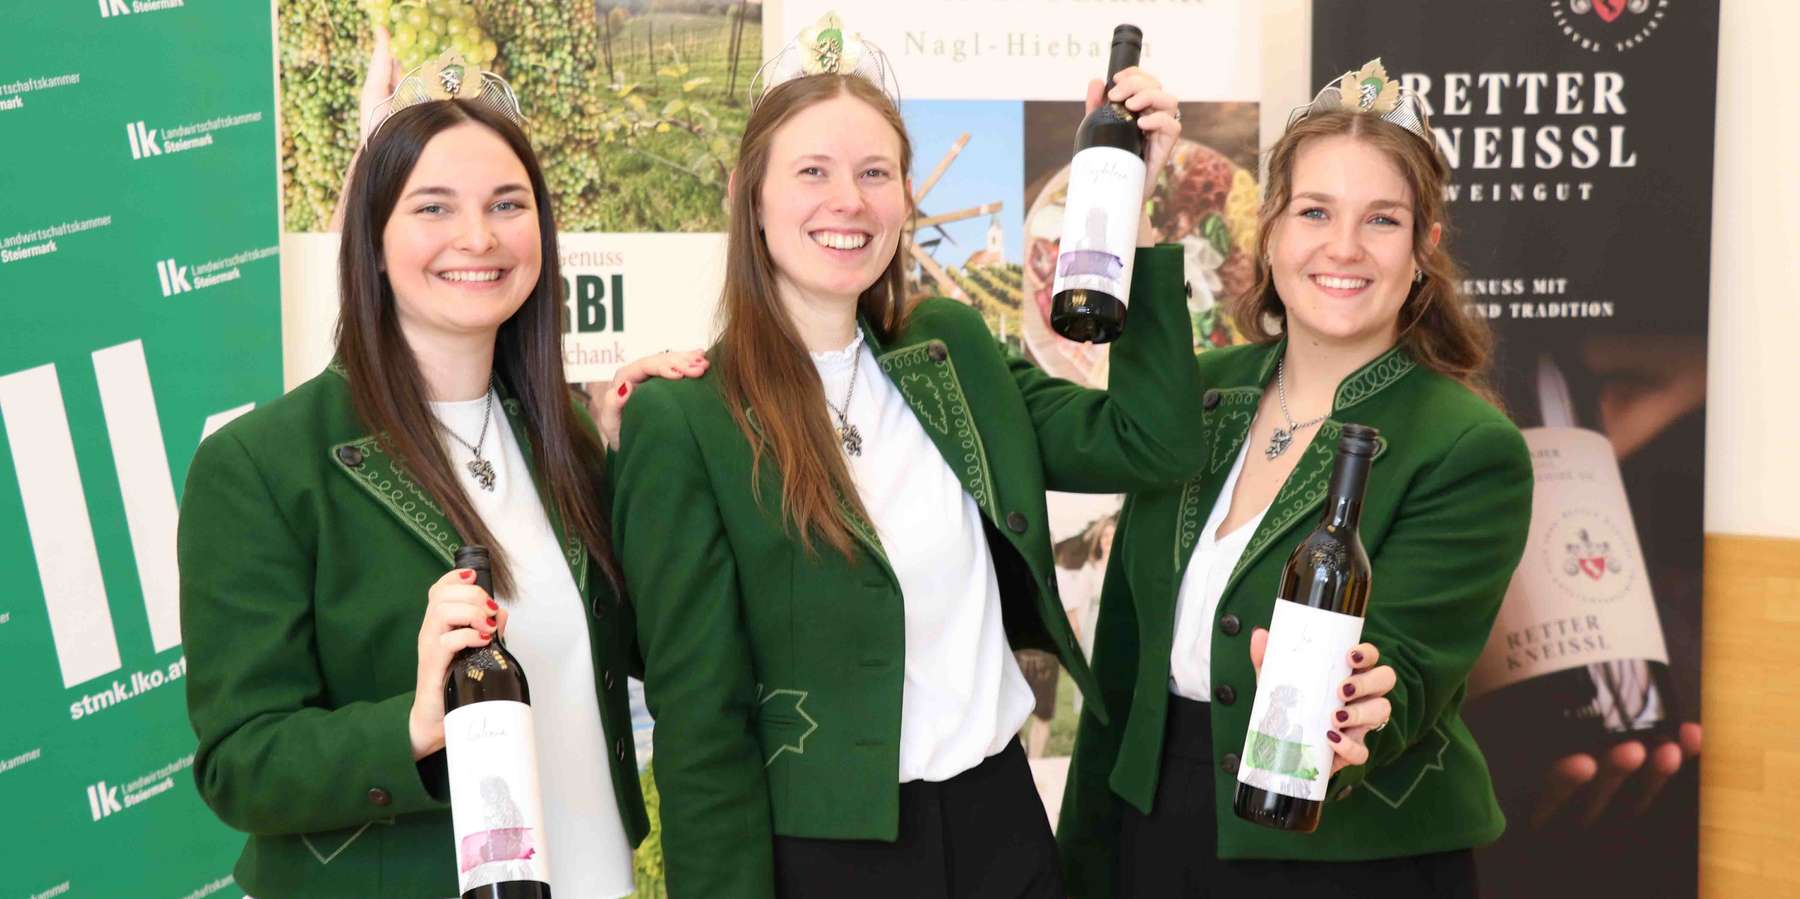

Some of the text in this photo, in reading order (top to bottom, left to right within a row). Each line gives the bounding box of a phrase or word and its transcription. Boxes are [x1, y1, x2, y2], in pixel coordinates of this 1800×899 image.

[904, 30, 1151, 63] Nagl-Hieba
[1401, 72, 1627, 116] RETTER
[127, 120, 162, 160] lk
[160, 111, 262, 141] Landwirtschaftskammer
[163, 133, 213, 154] Steiermark
[1432, 125, 1637, 169] NEISSL
[1444, 182, 1594, 202] WEINGUT
[0, 239, 57, 264] Steiermark
[156, 258, 193, 298] lk
[193, 267, 241, 290] Steiermark
[1532, 278, 1568, 295] MIT
[1509, 302, 1615, 319] TRADITION
[1505, 615, 1600, 651] RETTER
[87, 781, 122, 821] lk
[123, 777, 175, 809] Steiermark
